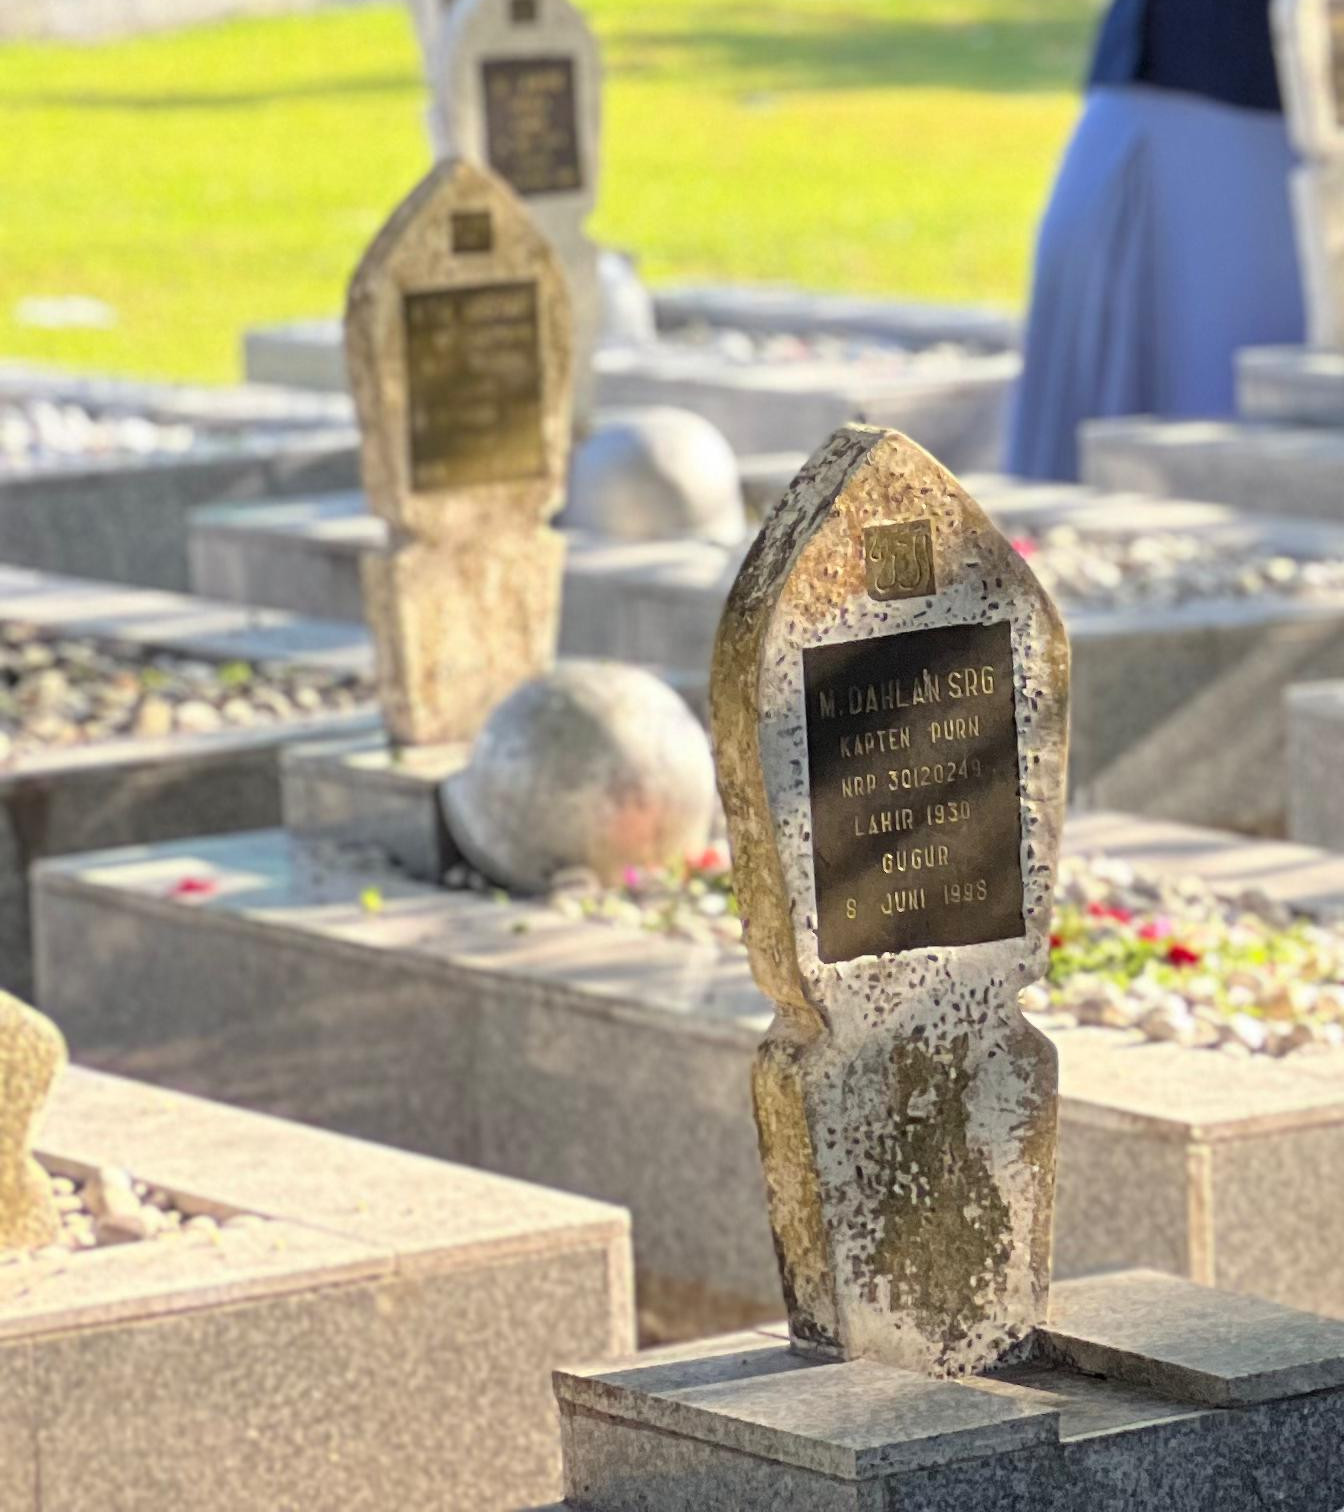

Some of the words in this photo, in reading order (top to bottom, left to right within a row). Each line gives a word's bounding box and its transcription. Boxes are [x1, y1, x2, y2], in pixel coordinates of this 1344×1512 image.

[948, 666, 994, 699] SRG
[840, 727, 911, 759] KAPTEN
[930, 715, 980, 744] PURN
[842, 774, 877, 798] NRP
[854, 808, 913, 836] LAHIR
[927, 801, 971, 825] 1930
[882, 844, 949, 874] GUGUR
[880, 887, 926, 915] JUNI
